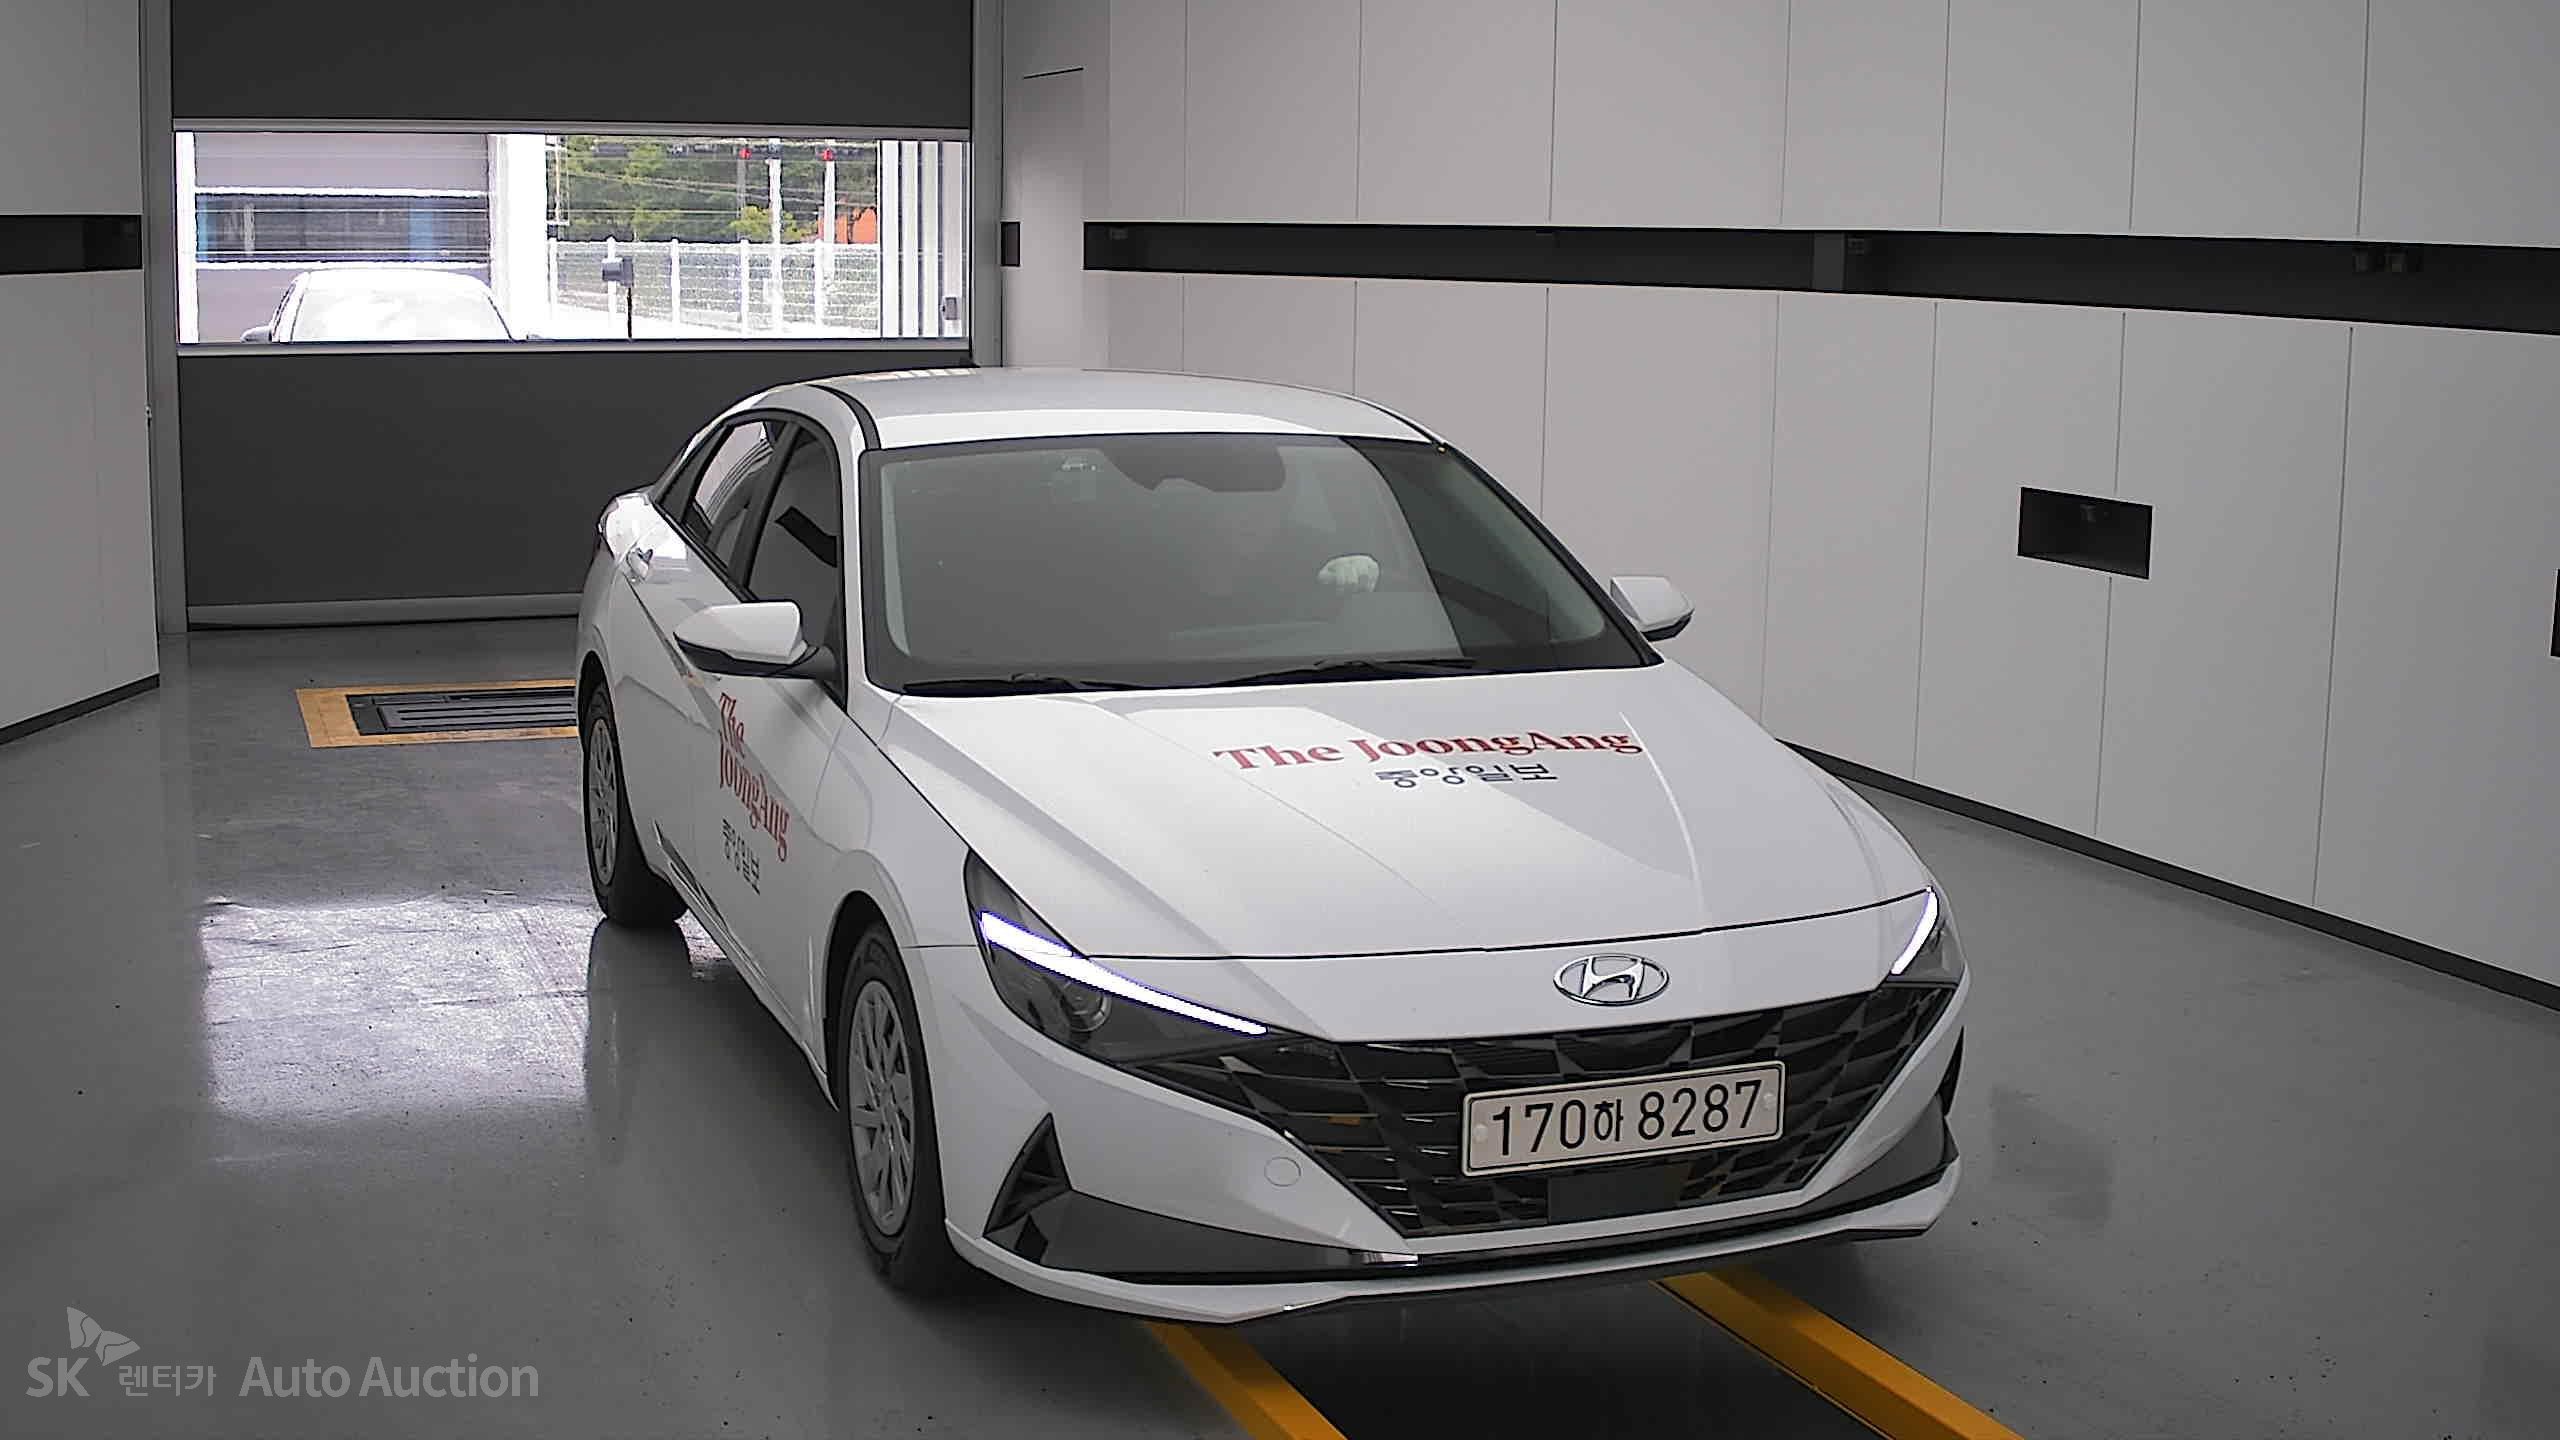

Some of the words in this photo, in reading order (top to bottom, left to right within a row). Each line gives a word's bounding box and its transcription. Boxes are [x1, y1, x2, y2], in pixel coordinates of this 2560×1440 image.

[719, 692, 745, 758] The
[1214, 747, 1345, 770] The
[1352, 731, 1643, 763] JoongAng
[720, 731, 790, 862] JoongAng
[1376, 763, 1558, 790] 중앙일보
[1637, 1079, 1763, 1142] 8287
